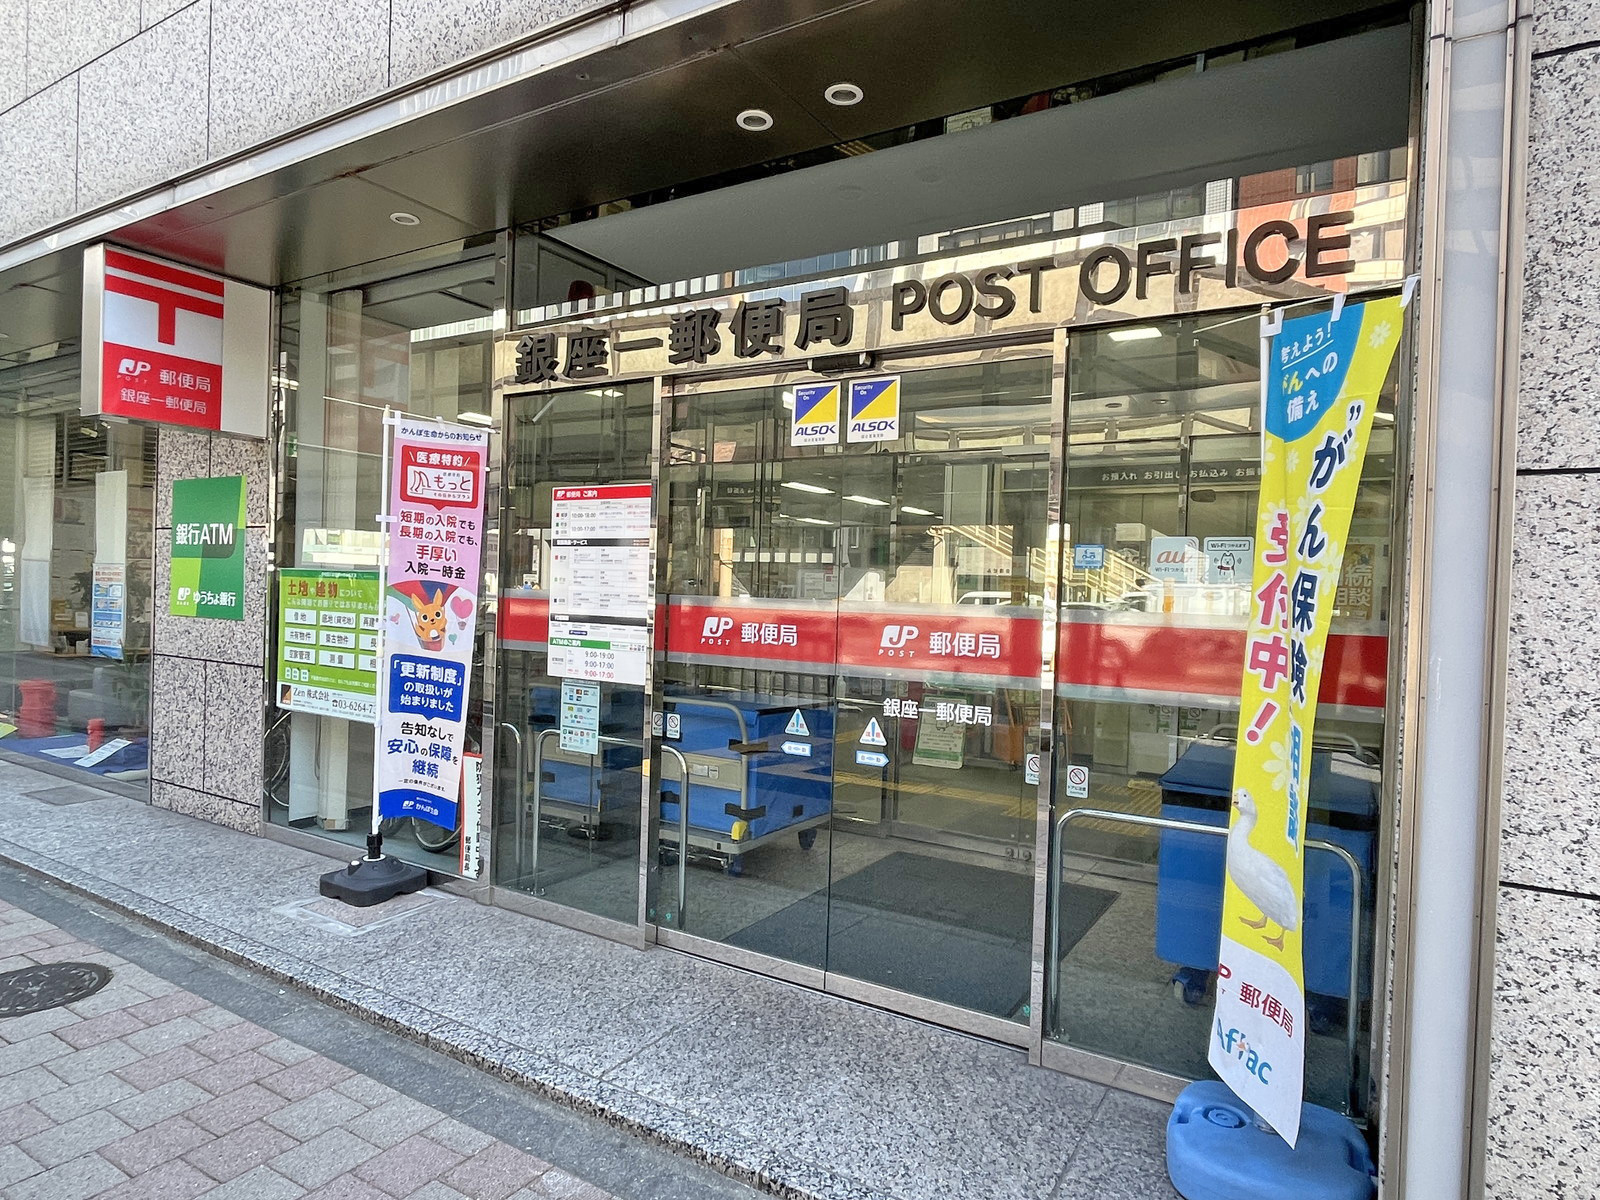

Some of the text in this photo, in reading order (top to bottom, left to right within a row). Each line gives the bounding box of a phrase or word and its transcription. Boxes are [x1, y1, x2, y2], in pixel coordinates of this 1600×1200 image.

[515, 211, 1356, 386] 銀座一郵便局 POST OFFICE
[118, 358, 151, 376] JP
[159, 369, 211, 393] 郵便局
[120, 387, 207, 415] 銀座一郵便局
[1287, 389, 1320, 424] 備え
[400, 427, 482, 441] かんぽ生命からのお知らせ
[795, 425, 836, 436] ALSOK
[851, 420, 895, 432] ALSOK
[416, 451, 464, 467] 医療特約
[434, 475, 471, 491] もっと
[1143, 471, 1180, 479] お引出し
[1189, 469, 1229, 478] お払込み
[400, 510, 476, 531] 短期の入院でも
[175, 523, 233, 545] 銀行ATM
[399, 525, 478, 546] 長期の入院でも、
[416, 544, 457, 562] 手厚い
[1156, 549, 1192, 564] au
[404, 560, 466, 579] 入院一時金
[193, 590, 236, 607] ゆうちょ銀行
[702, 616, 734, 638] JP
[740, 622, 798, 646] 郵便局
[880, 625, 919, 648] JP
[700, 638, 731, 646] POST
[929, 631, 1001, 659] 郵便局
[878, 649, 916, 658] POST
[393, 660, 462, 686] 「更新制度」
[306, 689, 330, 702] 株式会社
[403, 682, 453, 698] の取扱いが
[400, 694, 454, 713] 始まりました
[883, 697, 992, 726] 銀座一郵便局
[401, 721, 454, 742] 告知なしで
[387, 738, 459, 766] 安心の保障を
[412, 759, 439, 779] 継続
[1216, 963, 1232, 979] P
[1239, 981, 1294, 1038] 郵便局
